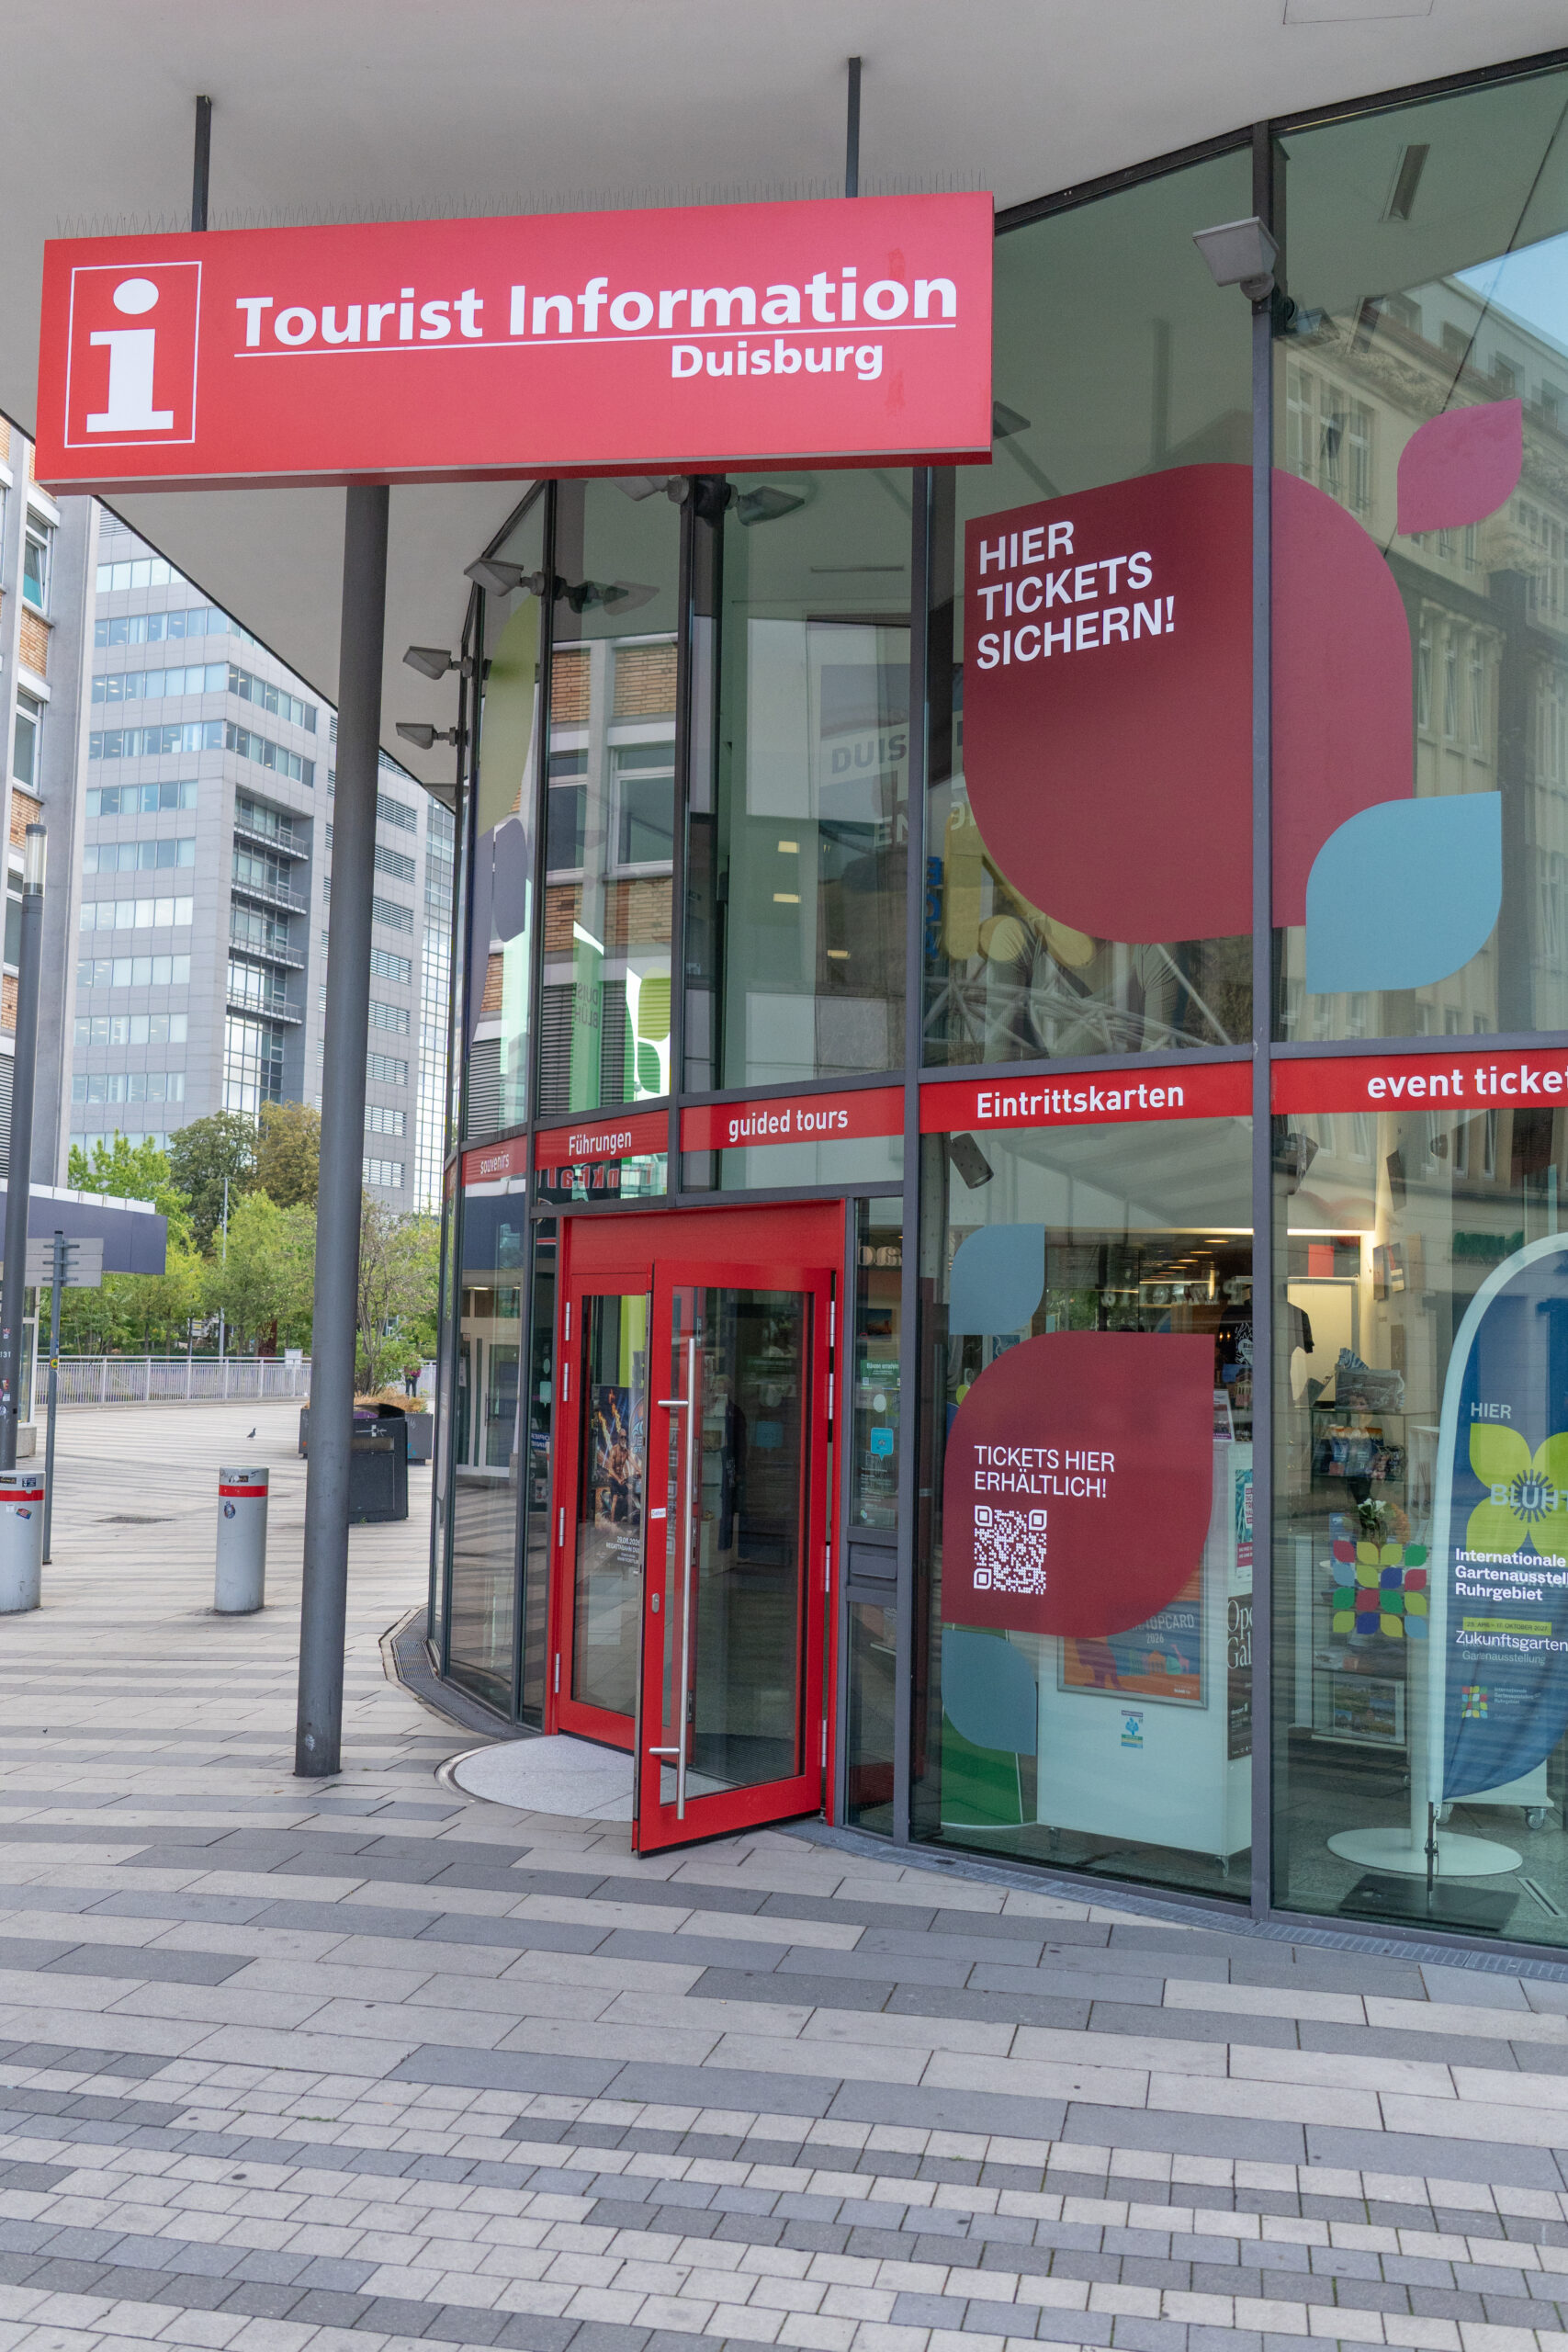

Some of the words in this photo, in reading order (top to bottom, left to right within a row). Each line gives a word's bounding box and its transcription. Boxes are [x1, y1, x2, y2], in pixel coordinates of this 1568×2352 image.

[236, 288, 484, 347] Tourist
[509, 266, 958, 336] Information
[671, 338, 884, 380] Duisburg
[979, 521, 1076, 575] HIER
[976, 551, 1154, 621] TICKETS
[976, 595, 1176, 670] SICHERN!
[1367, 1069, 1464, 1099] event
[1473, 1065, 1568, 1095] ticke
[977, 1084, 1184, 1118] Eintrittskarten
[728, 1109, 791, 1143] guided
[795, 1107, 849, 1131] tours
[568, 1128, 633, 1157] Führungen
[479, 1151, 511, 1176] souvenirs
[1471, 1402, 1512, 1419] HIER
[974, 1445, 1059, 1470] TICKETS
[1065, 1451, 1115, 1473] HIER
[974, 1468, 1107, 1498] ERHÄLTLICH!
[1455, 1547, 1567, 1567] Internationale
[1455, 1582, 1543, 1601] Ruhrgebiet
[1455, 1630, 1568, 1652] Zukunftsgarten
